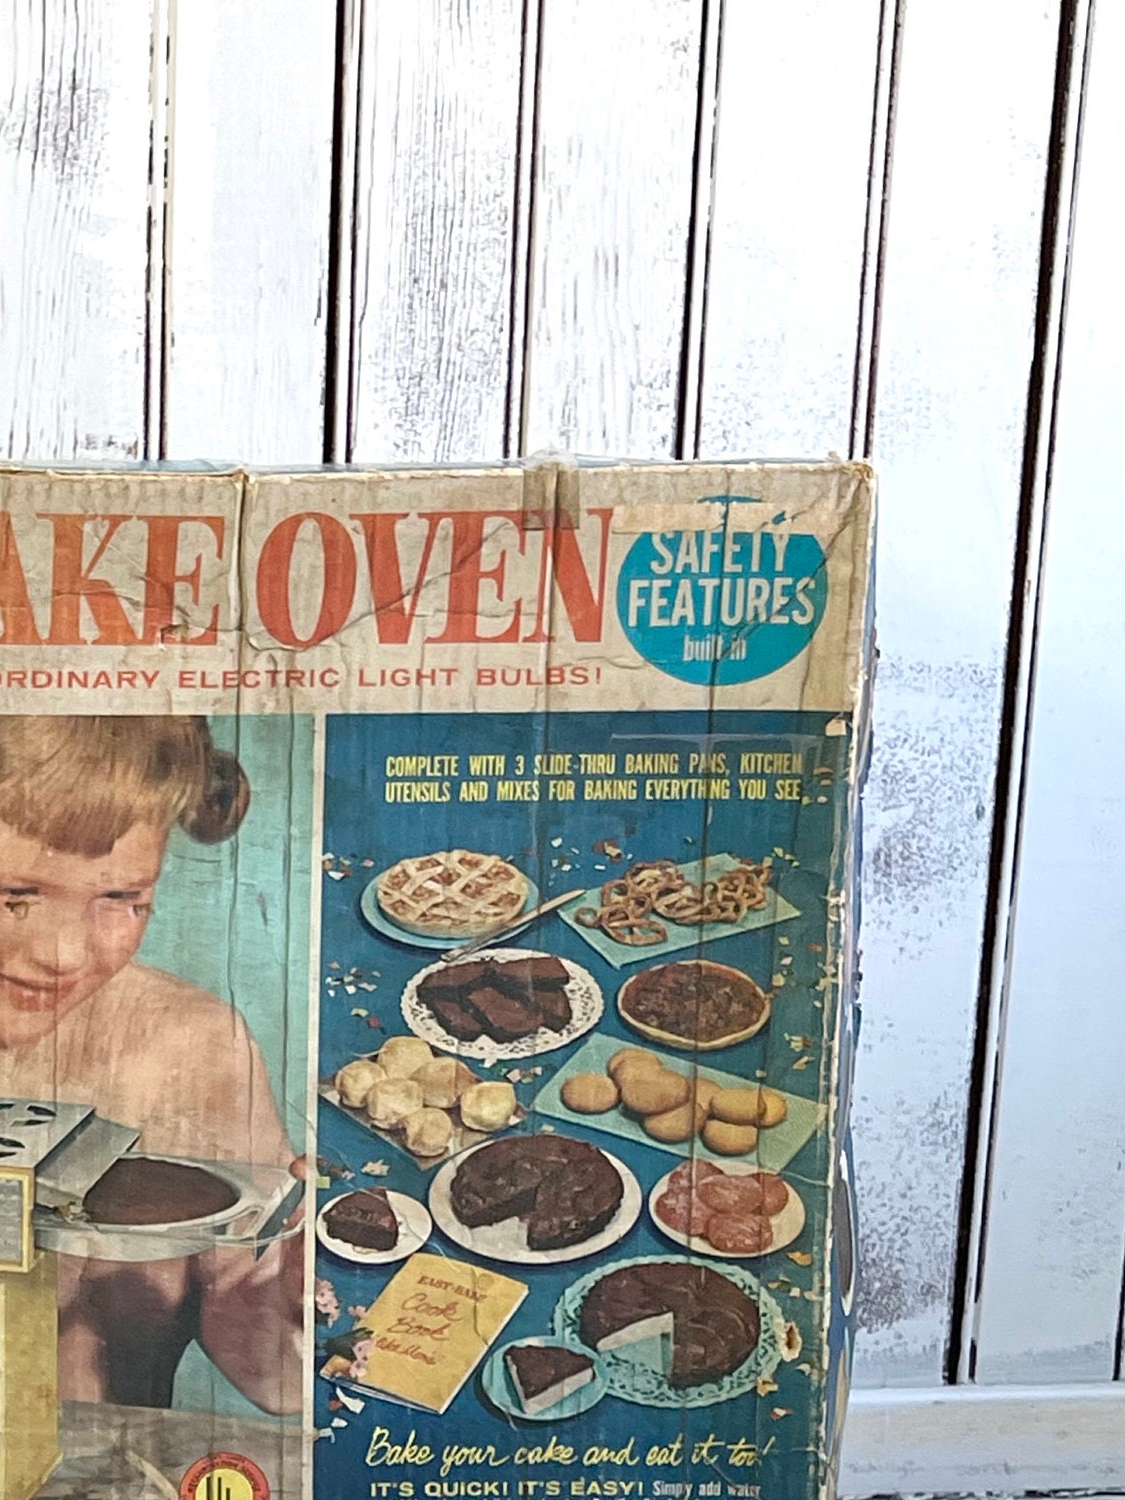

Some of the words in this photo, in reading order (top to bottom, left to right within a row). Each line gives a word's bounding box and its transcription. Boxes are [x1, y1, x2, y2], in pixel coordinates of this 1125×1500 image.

[649, 529, 791, 576] SAFETY
[255, 507, 615, 649] OVEN
[627, 576, 817, 628] FEATURES
[177, 668, 341, 689] ELECTRIC
[358, 667, 459, 688] LIGHT
[476, 666, 602, 687] BULBS!
[386, 755, 459, 777] COMPLETE
[469, 754, 505, 777] WITH
[514, 754, 525, 776] 3
[625, 753, 679, 775] BAKING
[739, 753, 803, 775] KITCHEN
[385, 781, 451, 803] UTENSILS
[458, 780, 488, 802] AND
[496, 780, 541, 802] MIXES
[548, 779, 576, 801] FOR
[584, 778, 638, 801] BAKING
[645, 778, 730, 800] EVERYTHING
[738, 777, 767, 800] YOU
[401, 1292, 463, 1323] Cook
[365, 1426, 435, 1467] Bake
[440, 1445, 510, 1477] your
[513, 1435, 579, 1466] cake
[583, 1436, 640, 1466] and
[645, 1432, 685, 1466] eat
[691, 1433, 726, 1466] it
[370, 1481, 414, 1498] IT'S
[424, 1481, 508, 1498] QUICK!
[518, 1480, 561, 1497] IT'S
[570, 1480, 644, 1497] EASY!
[699, 1480, 722, 1497] add
